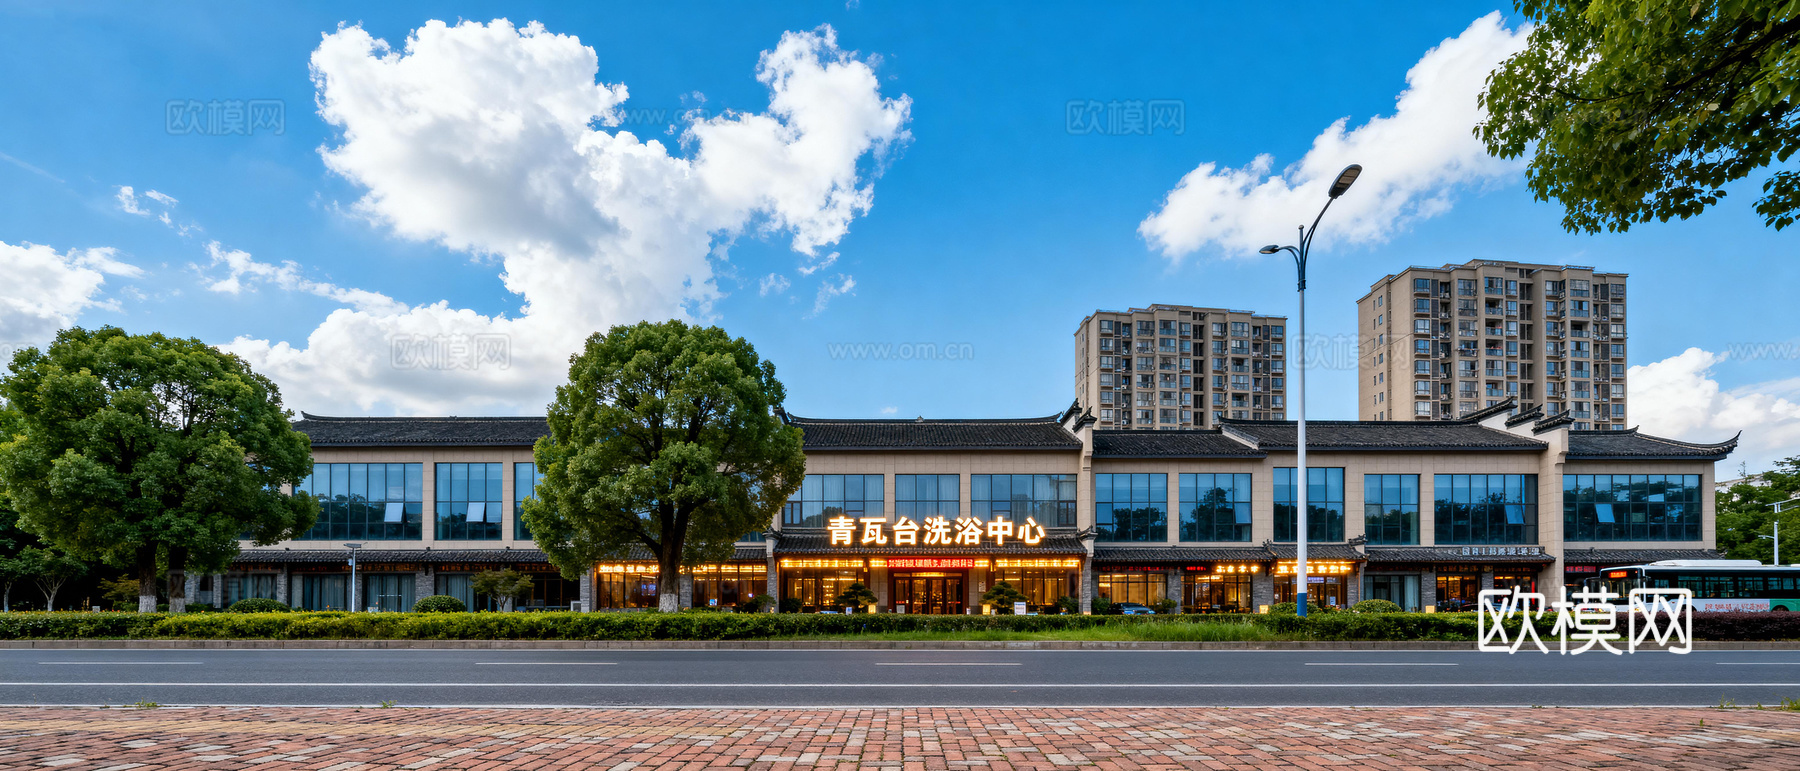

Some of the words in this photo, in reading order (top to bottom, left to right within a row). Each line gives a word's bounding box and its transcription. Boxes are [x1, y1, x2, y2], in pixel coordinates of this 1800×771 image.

[827, 516, 1045, 545] 青瓦台洗浴中心
